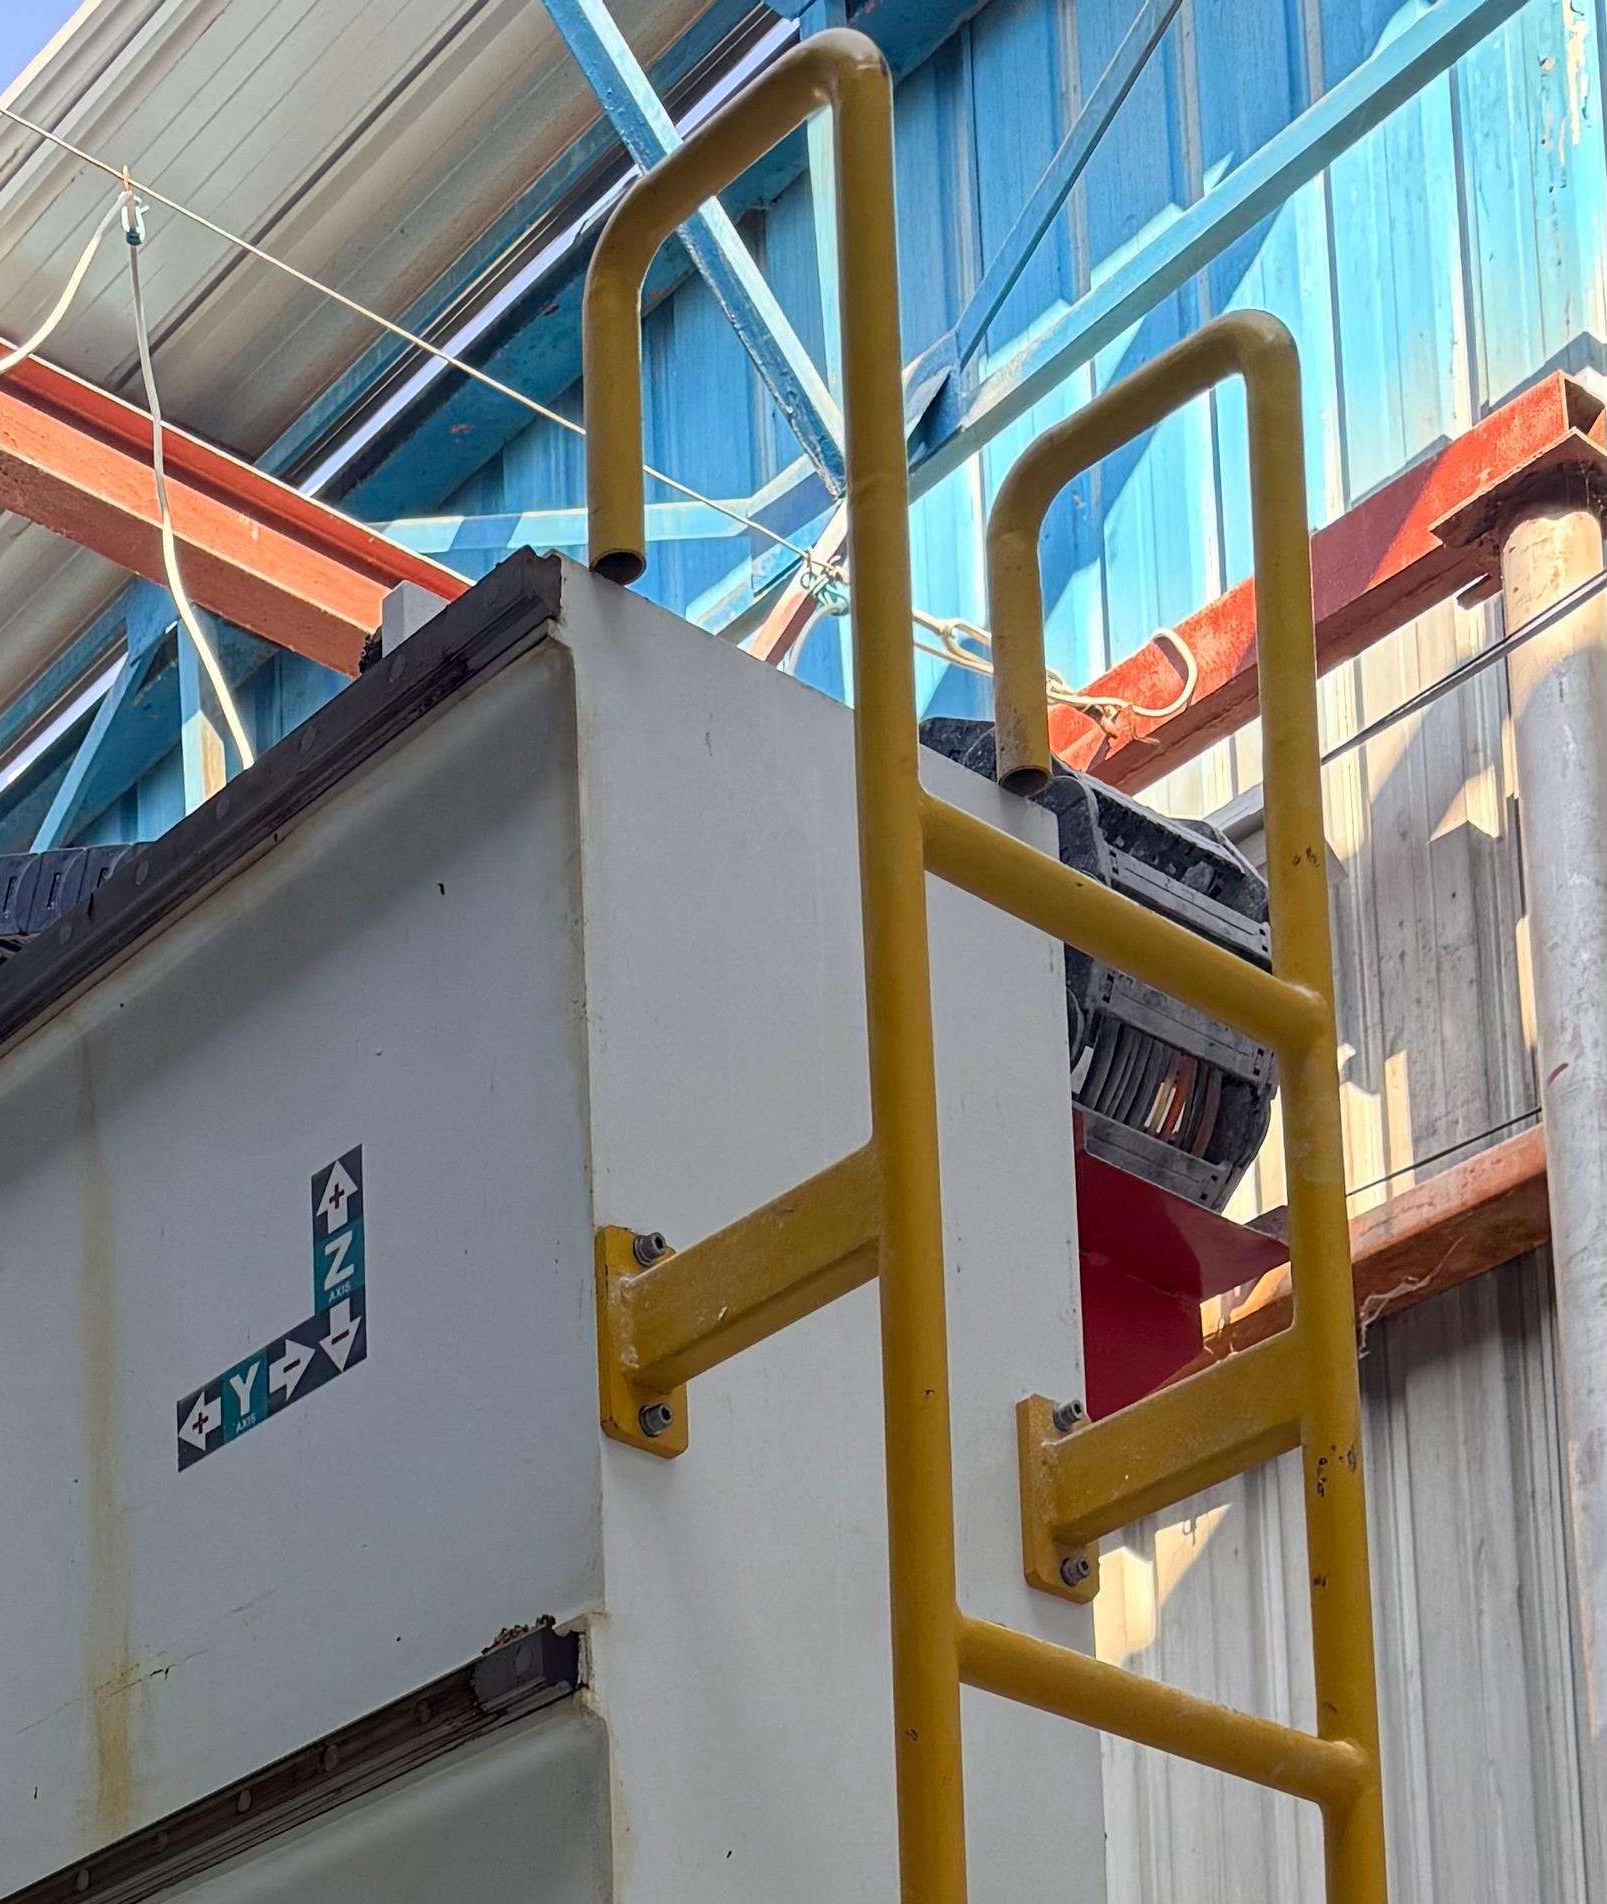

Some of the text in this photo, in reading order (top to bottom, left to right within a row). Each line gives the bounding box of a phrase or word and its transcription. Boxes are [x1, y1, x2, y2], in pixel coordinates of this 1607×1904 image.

[324, 1229, 354, 1291] Z
[328, 1280, 351, 1304] AXIS
[229, 1360, 261, 1417] Y
[235, 1412, 256, 1433] AXIS
